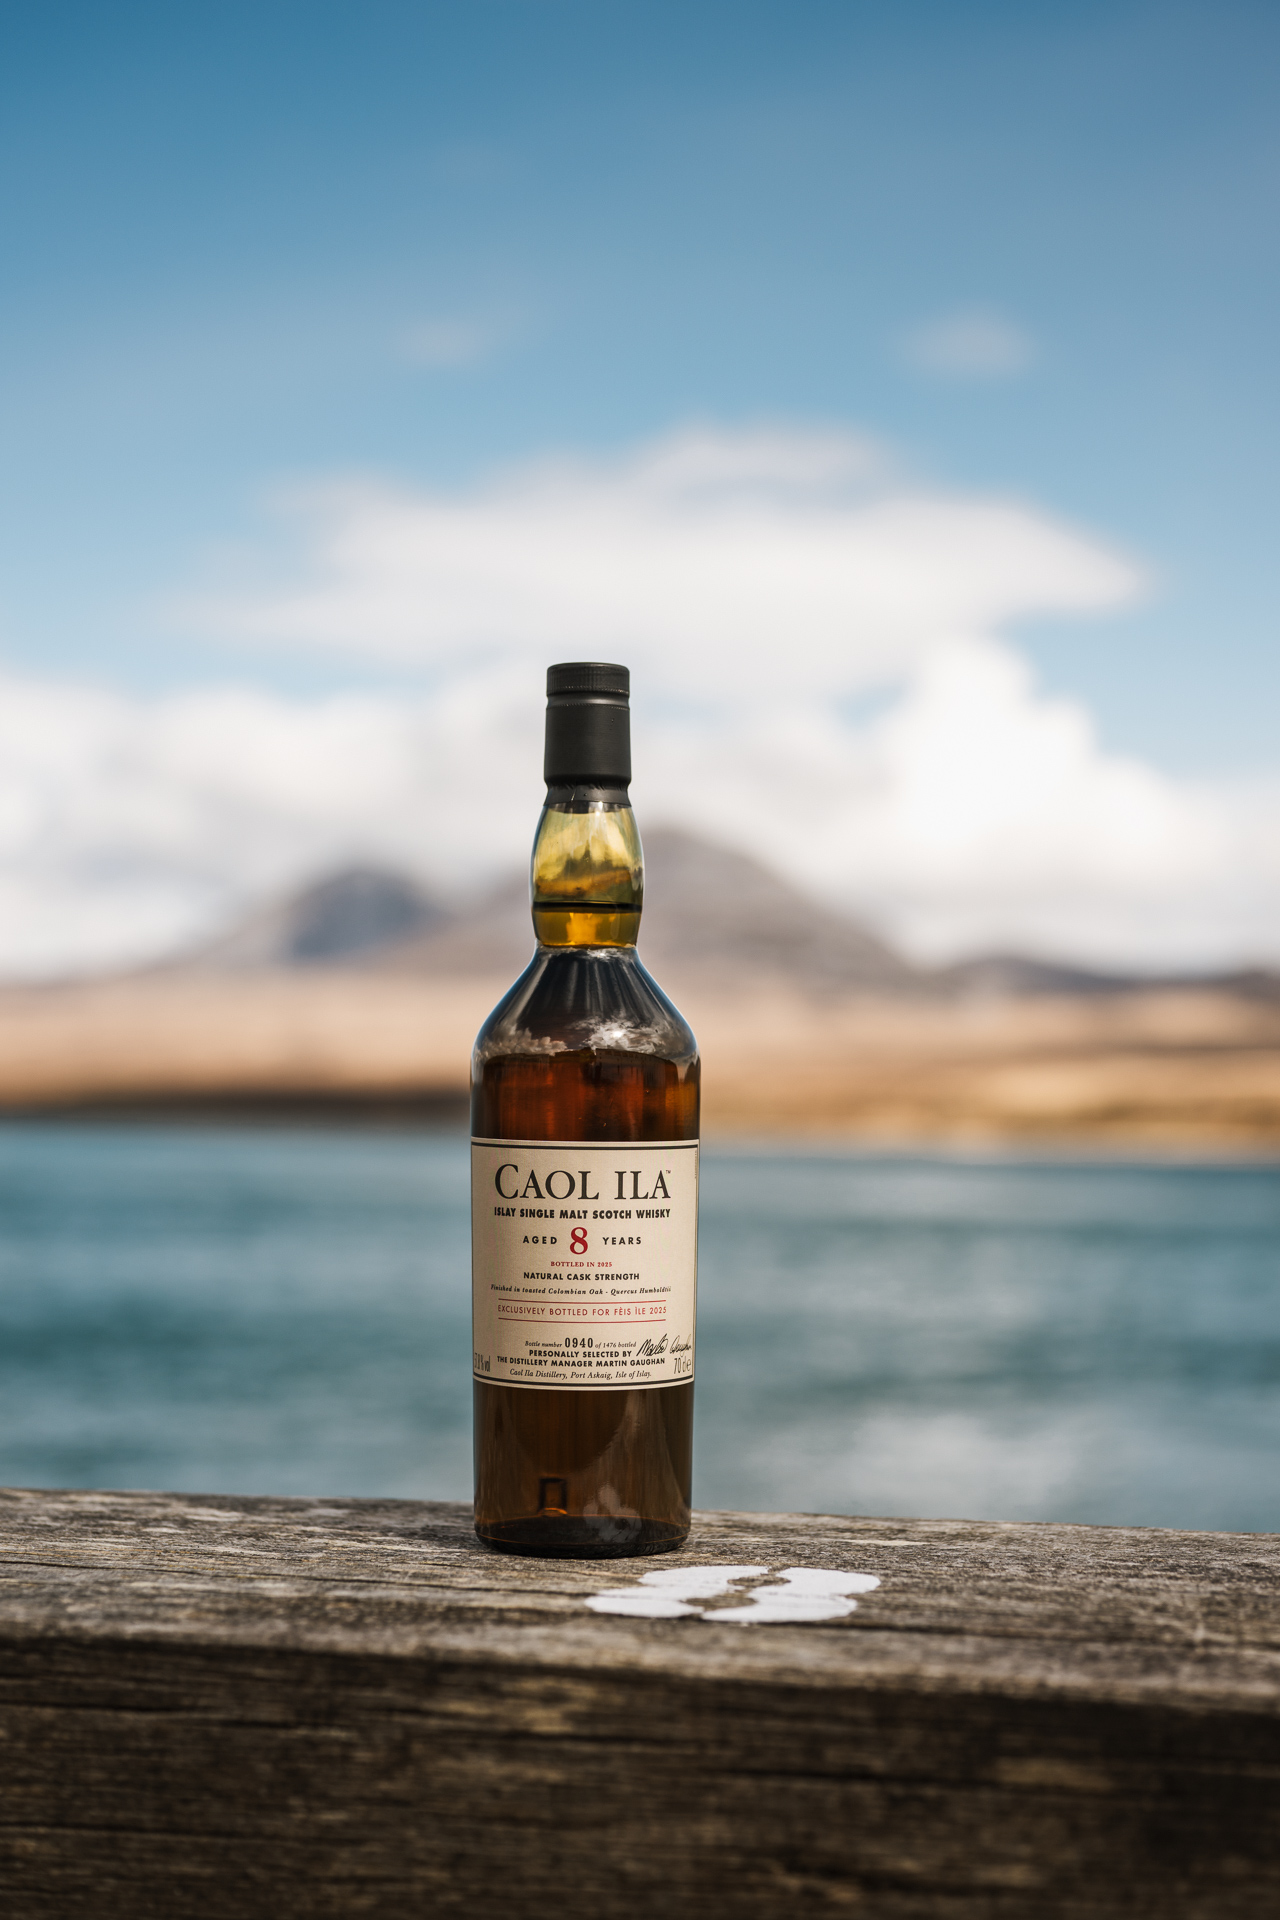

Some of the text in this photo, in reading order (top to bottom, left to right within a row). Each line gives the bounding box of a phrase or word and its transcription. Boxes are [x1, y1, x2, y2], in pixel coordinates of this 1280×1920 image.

[495, 1164, 600, 1200] CAOL
[494, 1207, 671, 1219] ISLAY SINGLE MALT SCOTCH WHISKY
[523, 1226, 642, 1255] AGED 8 YEARS
[524, 1272, 563, 1280] NATURAL
[498, 1305, 545, 1315] EXCLUSIVELY
[614, 1307, 631, 1316] FÈIS
[635, 1306, 646, 1315] ÌLE
[649, 1306, 666, 1315] 2025
[564, 1338, 593, 1348] 0940
[510, 1358, 548, 1366] DISTILLERY
[630, 1358, 665, 1366] GAUGHAN
[535, 1370, 568, 1380] Distillery,
[587, 1372, 612, 1380] Askaig,
[628, 1370, 635, 1379] of
[636, 1370, 651, 1379] Islay.
